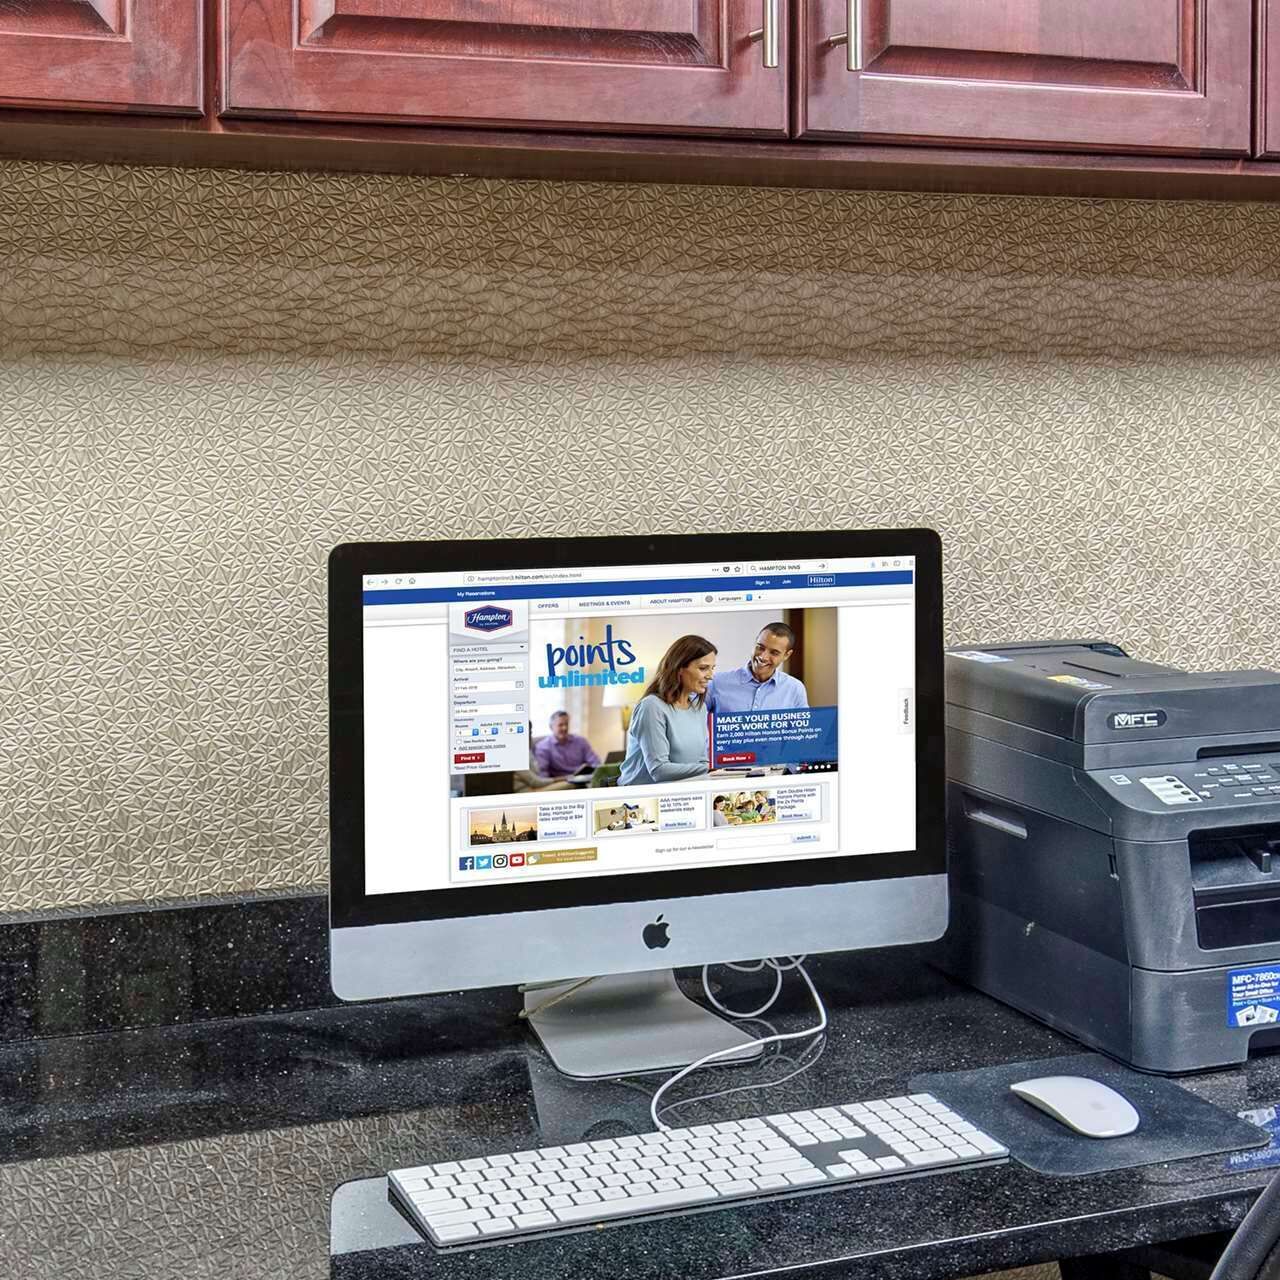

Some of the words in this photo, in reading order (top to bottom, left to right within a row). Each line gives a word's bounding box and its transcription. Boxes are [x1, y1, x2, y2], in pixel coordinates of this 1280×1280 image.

[810, 576, 833, 584] Hilton
[467, 611, 510, 623] Hampton
[547, 624, 637, 684] points
[538, 667, 645, 689] unlimited
[717, 716, 743, 724] MAKE
[772, 712, 811, 721] BUSINESS
[1114, 713, 1158, 726] MFC
